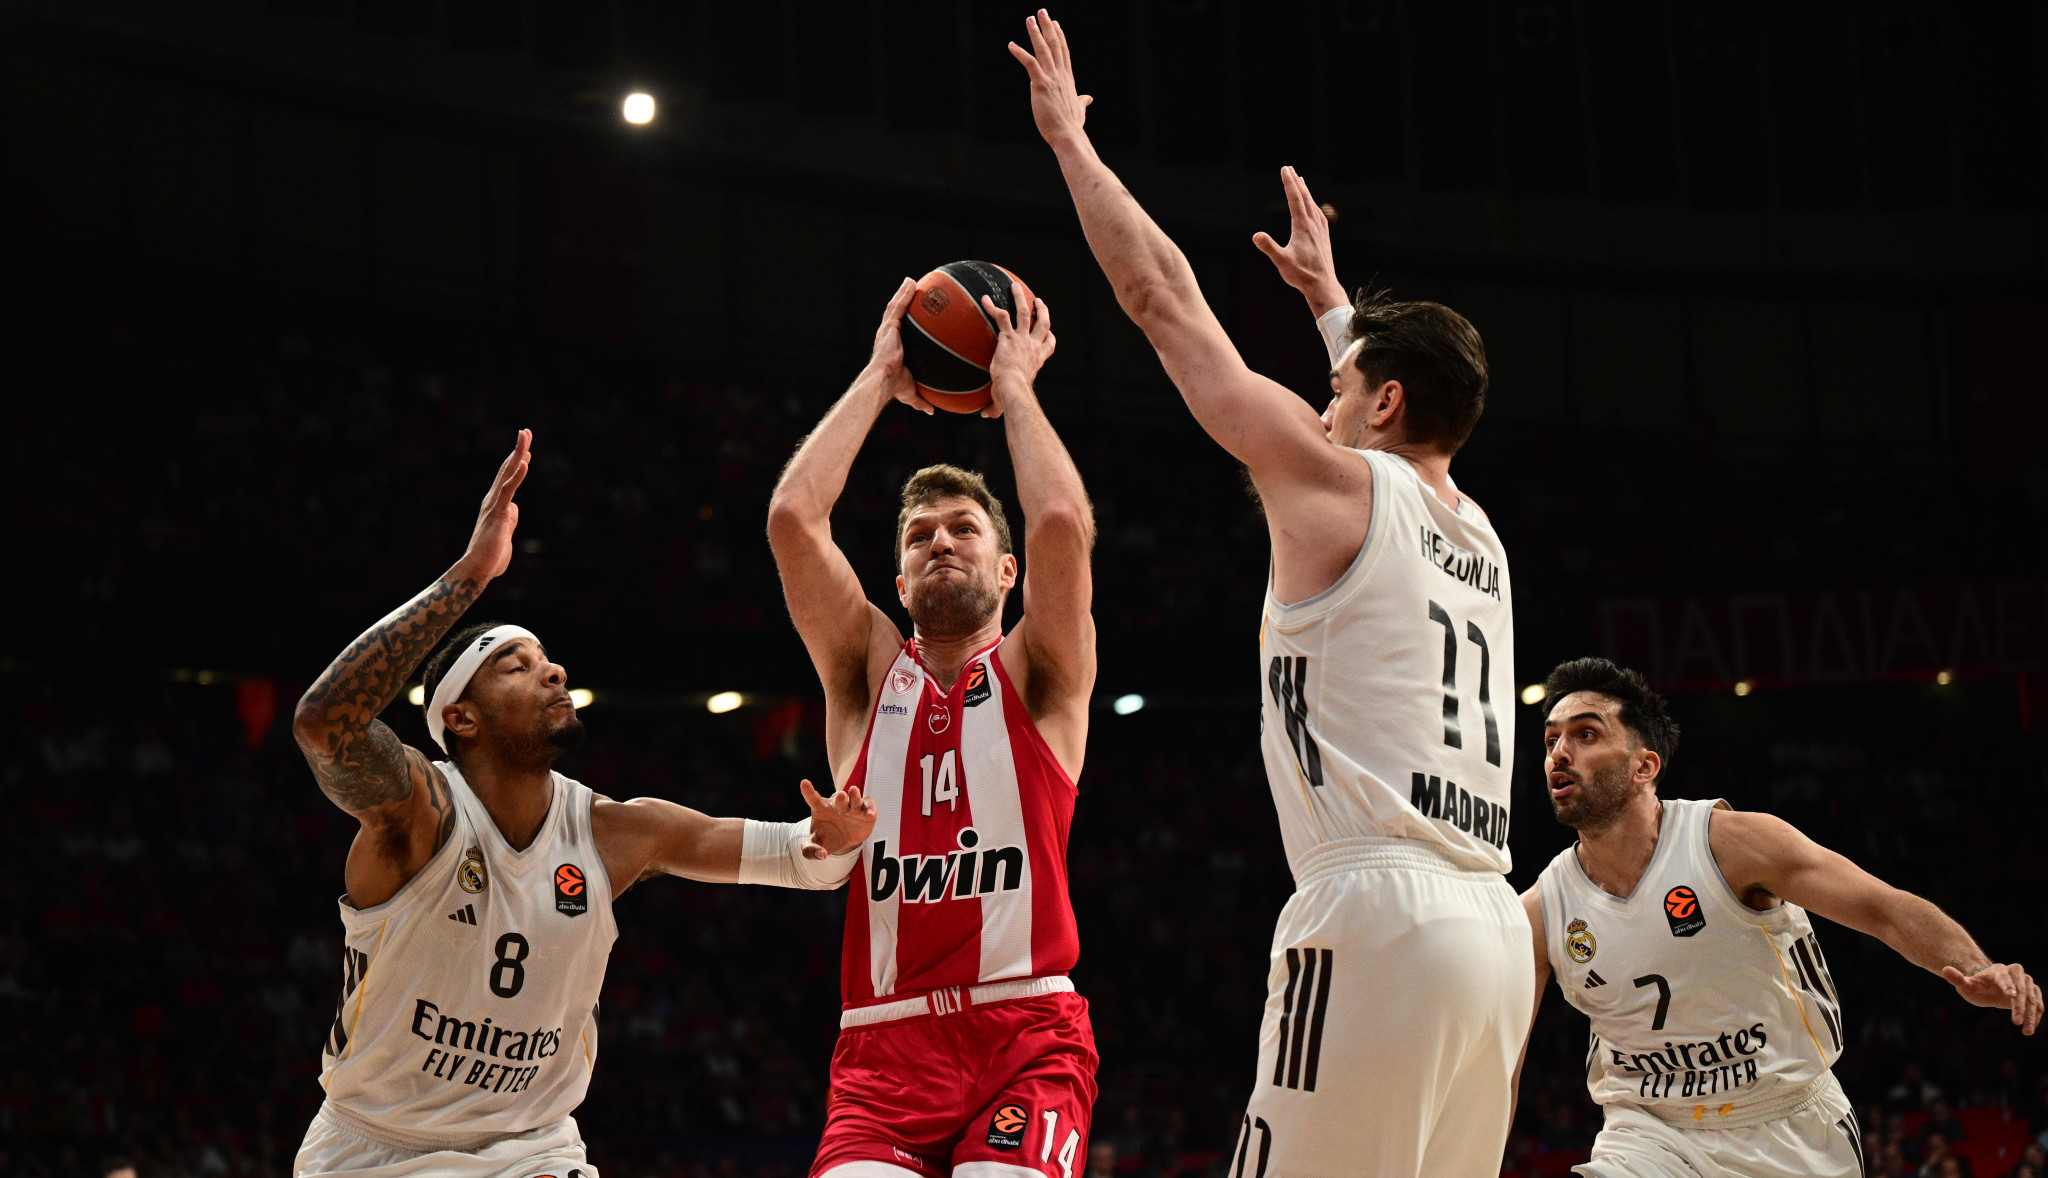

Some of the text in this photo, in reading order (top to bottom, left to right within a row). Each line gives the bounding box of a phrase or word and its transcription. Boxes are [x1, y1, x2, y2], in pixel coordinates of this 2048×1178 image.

[1420, 524, 1501, 602] HEZONJA
[919, 748, 960, 817] 14
[1411, 772, 1508, 851] MADRID
[870, 826, 1024, 904] bwin
[489, 932, 529, 998] 8
[411, 998, 562, 1061] Emirates
[931, 985, 963, 1016] OLY
[1633, 973, 1671, 1031] 7
[421, 1048, 540, 1094] FLY BETTER
[1610, 1022, 1767, 1075] Emirates
[1639, 1058, 1758, 1099] FLY BETTER
[1040, 1109, 1081, 1178] 14
